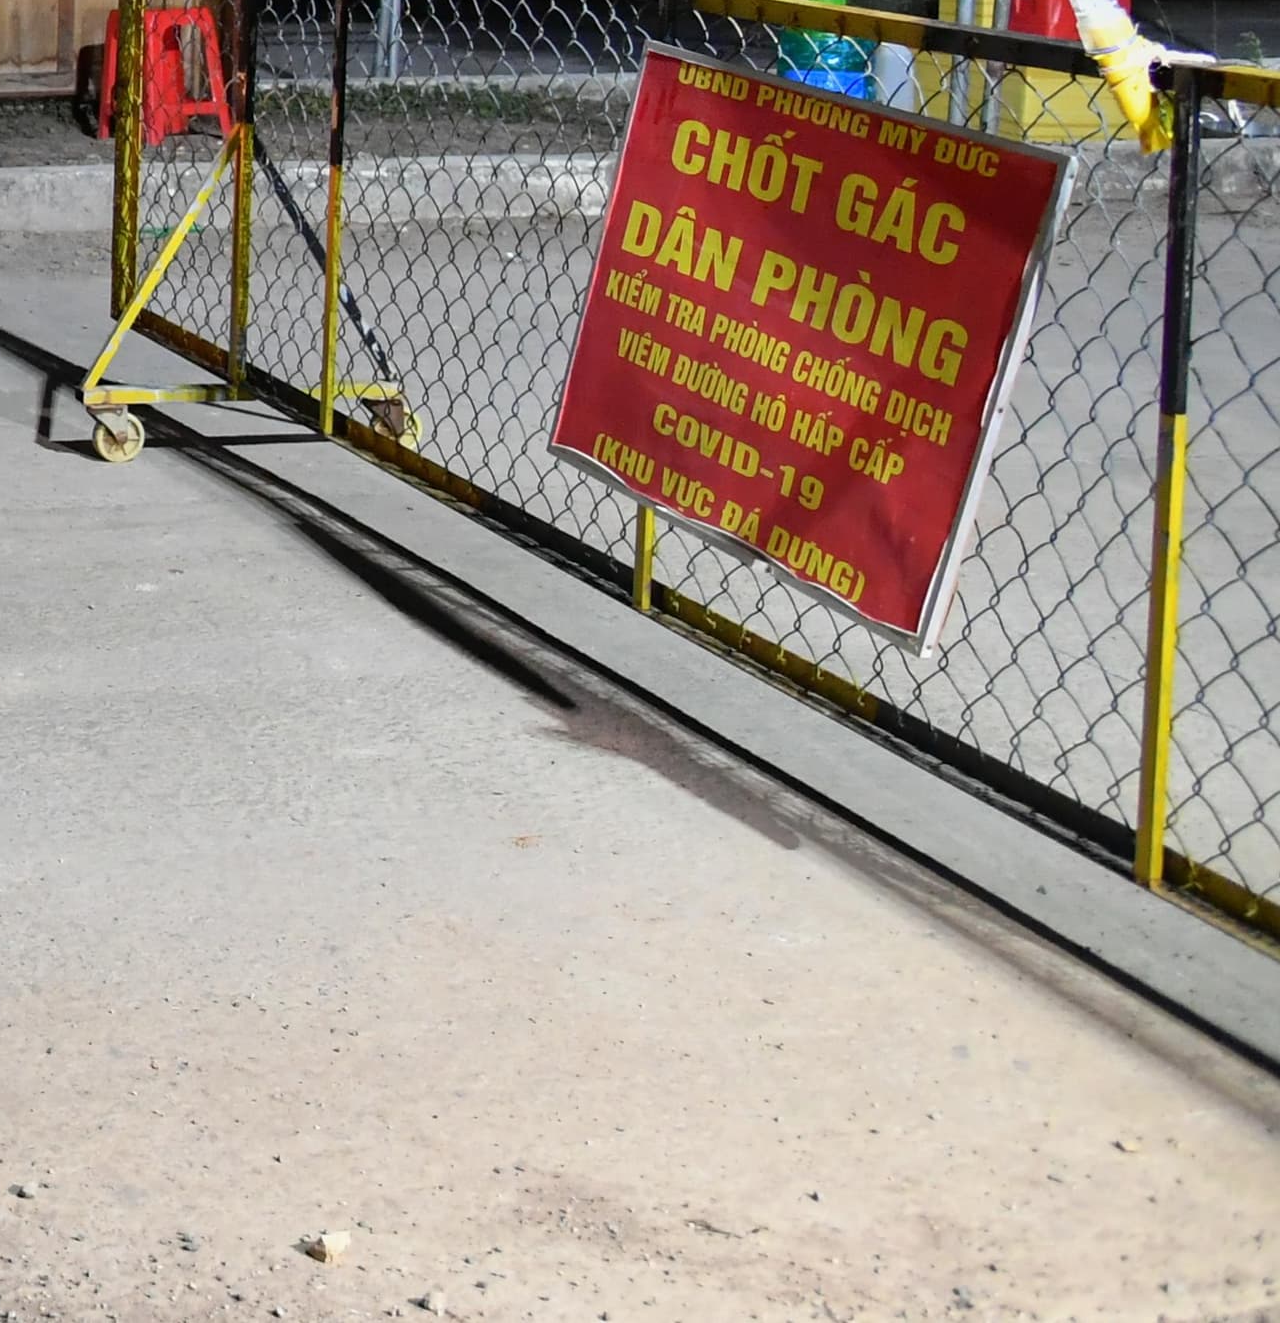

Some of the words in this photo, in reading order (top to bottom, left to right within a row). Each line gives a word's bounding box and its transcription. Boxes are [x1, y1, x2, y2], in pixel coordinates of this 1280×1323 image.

[671, 119, 824, 215] CHỐT
[835, 173, 966, 265] GÁC
[678, 61, 750, 101] UBND
[878, 120, 928, 155] MỸ
[934, 138, 1000, 177] ĐỨC
[605, 268, 663, 316] KIỂM
[665, 293, 705, 338] TRA
[708, 312, 790, 374] PHÒNG
[792, 351, 882, 415] CHỐNG
[884, 389, 953, 447] DỊCH
[621, 200, 744, 293] DÂN
[750, 250, 969, 387] PHÒNG
[617, 327, 672, 377] VIÊM
[671, 354, 749, 415] ĐƯỜNG
[751, 391, 787, 433] HÔ
[790, 409, 845, 456] HẤP
[849, 437, 905, 485] CẤP
[652, 403, 824, 511] COVID-19
[592, 433, 655, 485] (KHU
[661, 465, 716, 518] VỰC
[719, 499, 761, 545] ĐÁ
